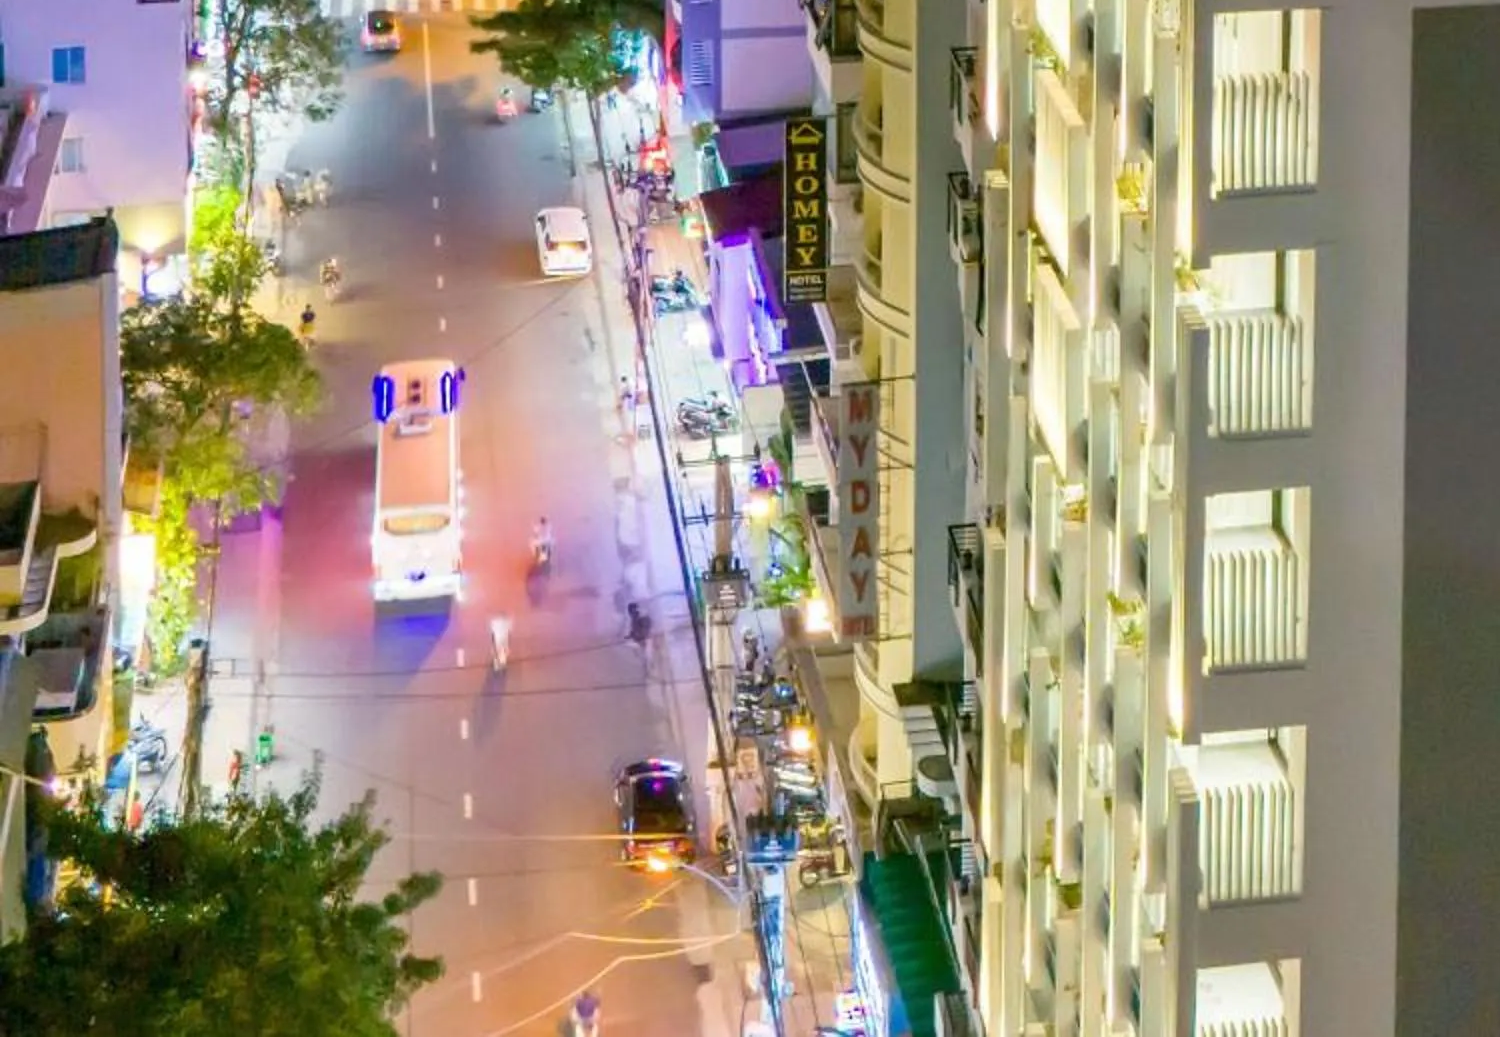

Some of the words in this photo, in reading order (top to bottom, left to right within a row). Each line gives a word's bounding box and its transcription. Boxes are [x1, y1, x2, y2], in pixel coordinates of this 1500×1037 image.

[793, 153, 819, 266] HOMEY
[789, 274, 824, 286] HOTEL
[849, 390, 873, 603] MYDAY
